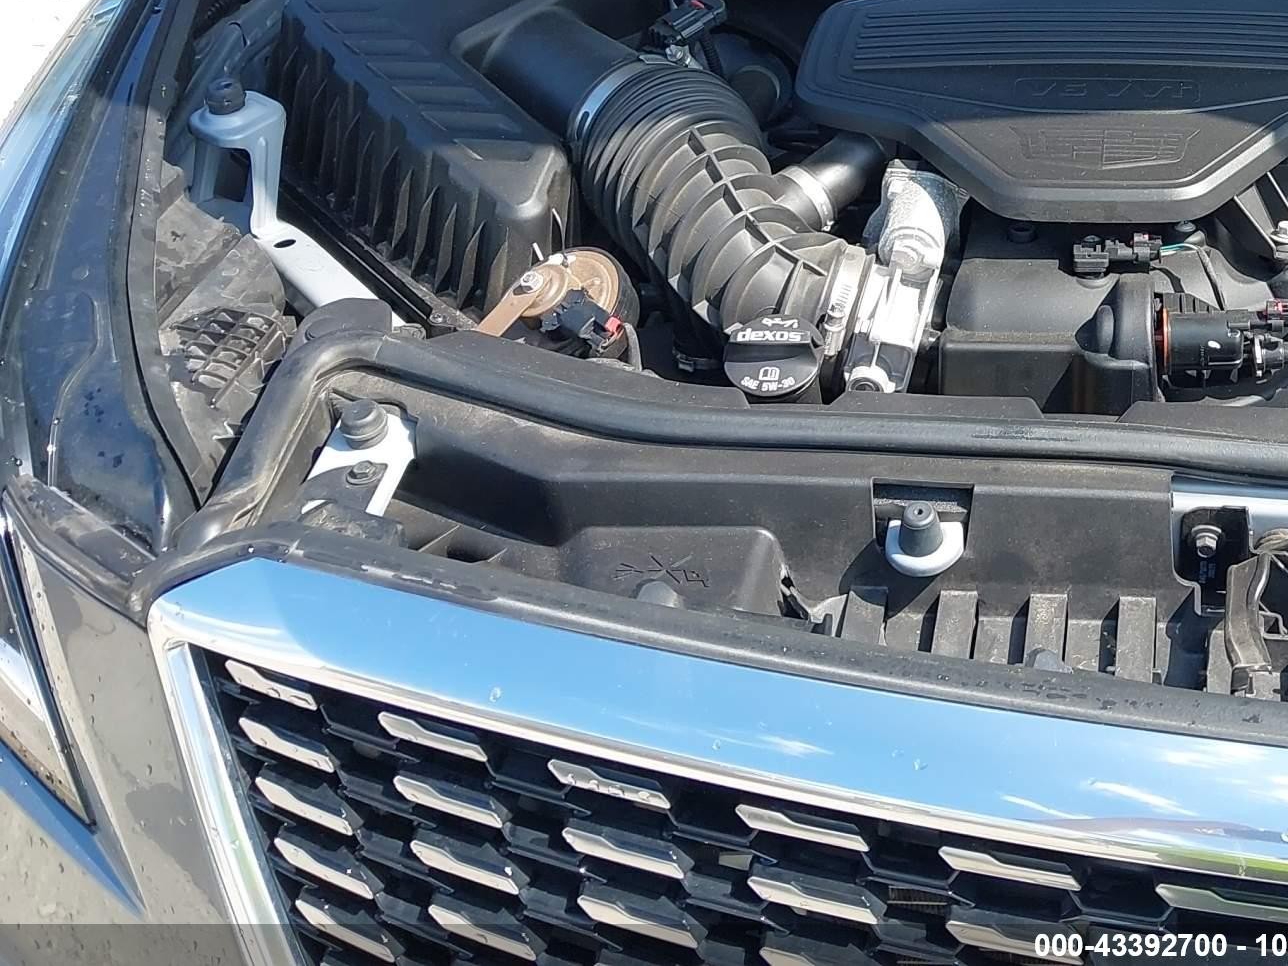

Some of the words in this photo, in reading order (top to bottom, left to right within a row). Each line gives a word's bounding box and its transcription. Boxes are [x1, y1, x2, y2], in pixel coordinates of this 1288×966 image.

[737, 328, 801, 342] dexos
[741, 377, 760, 390] SAE
[761, 377, 796, 392] 5W-30
